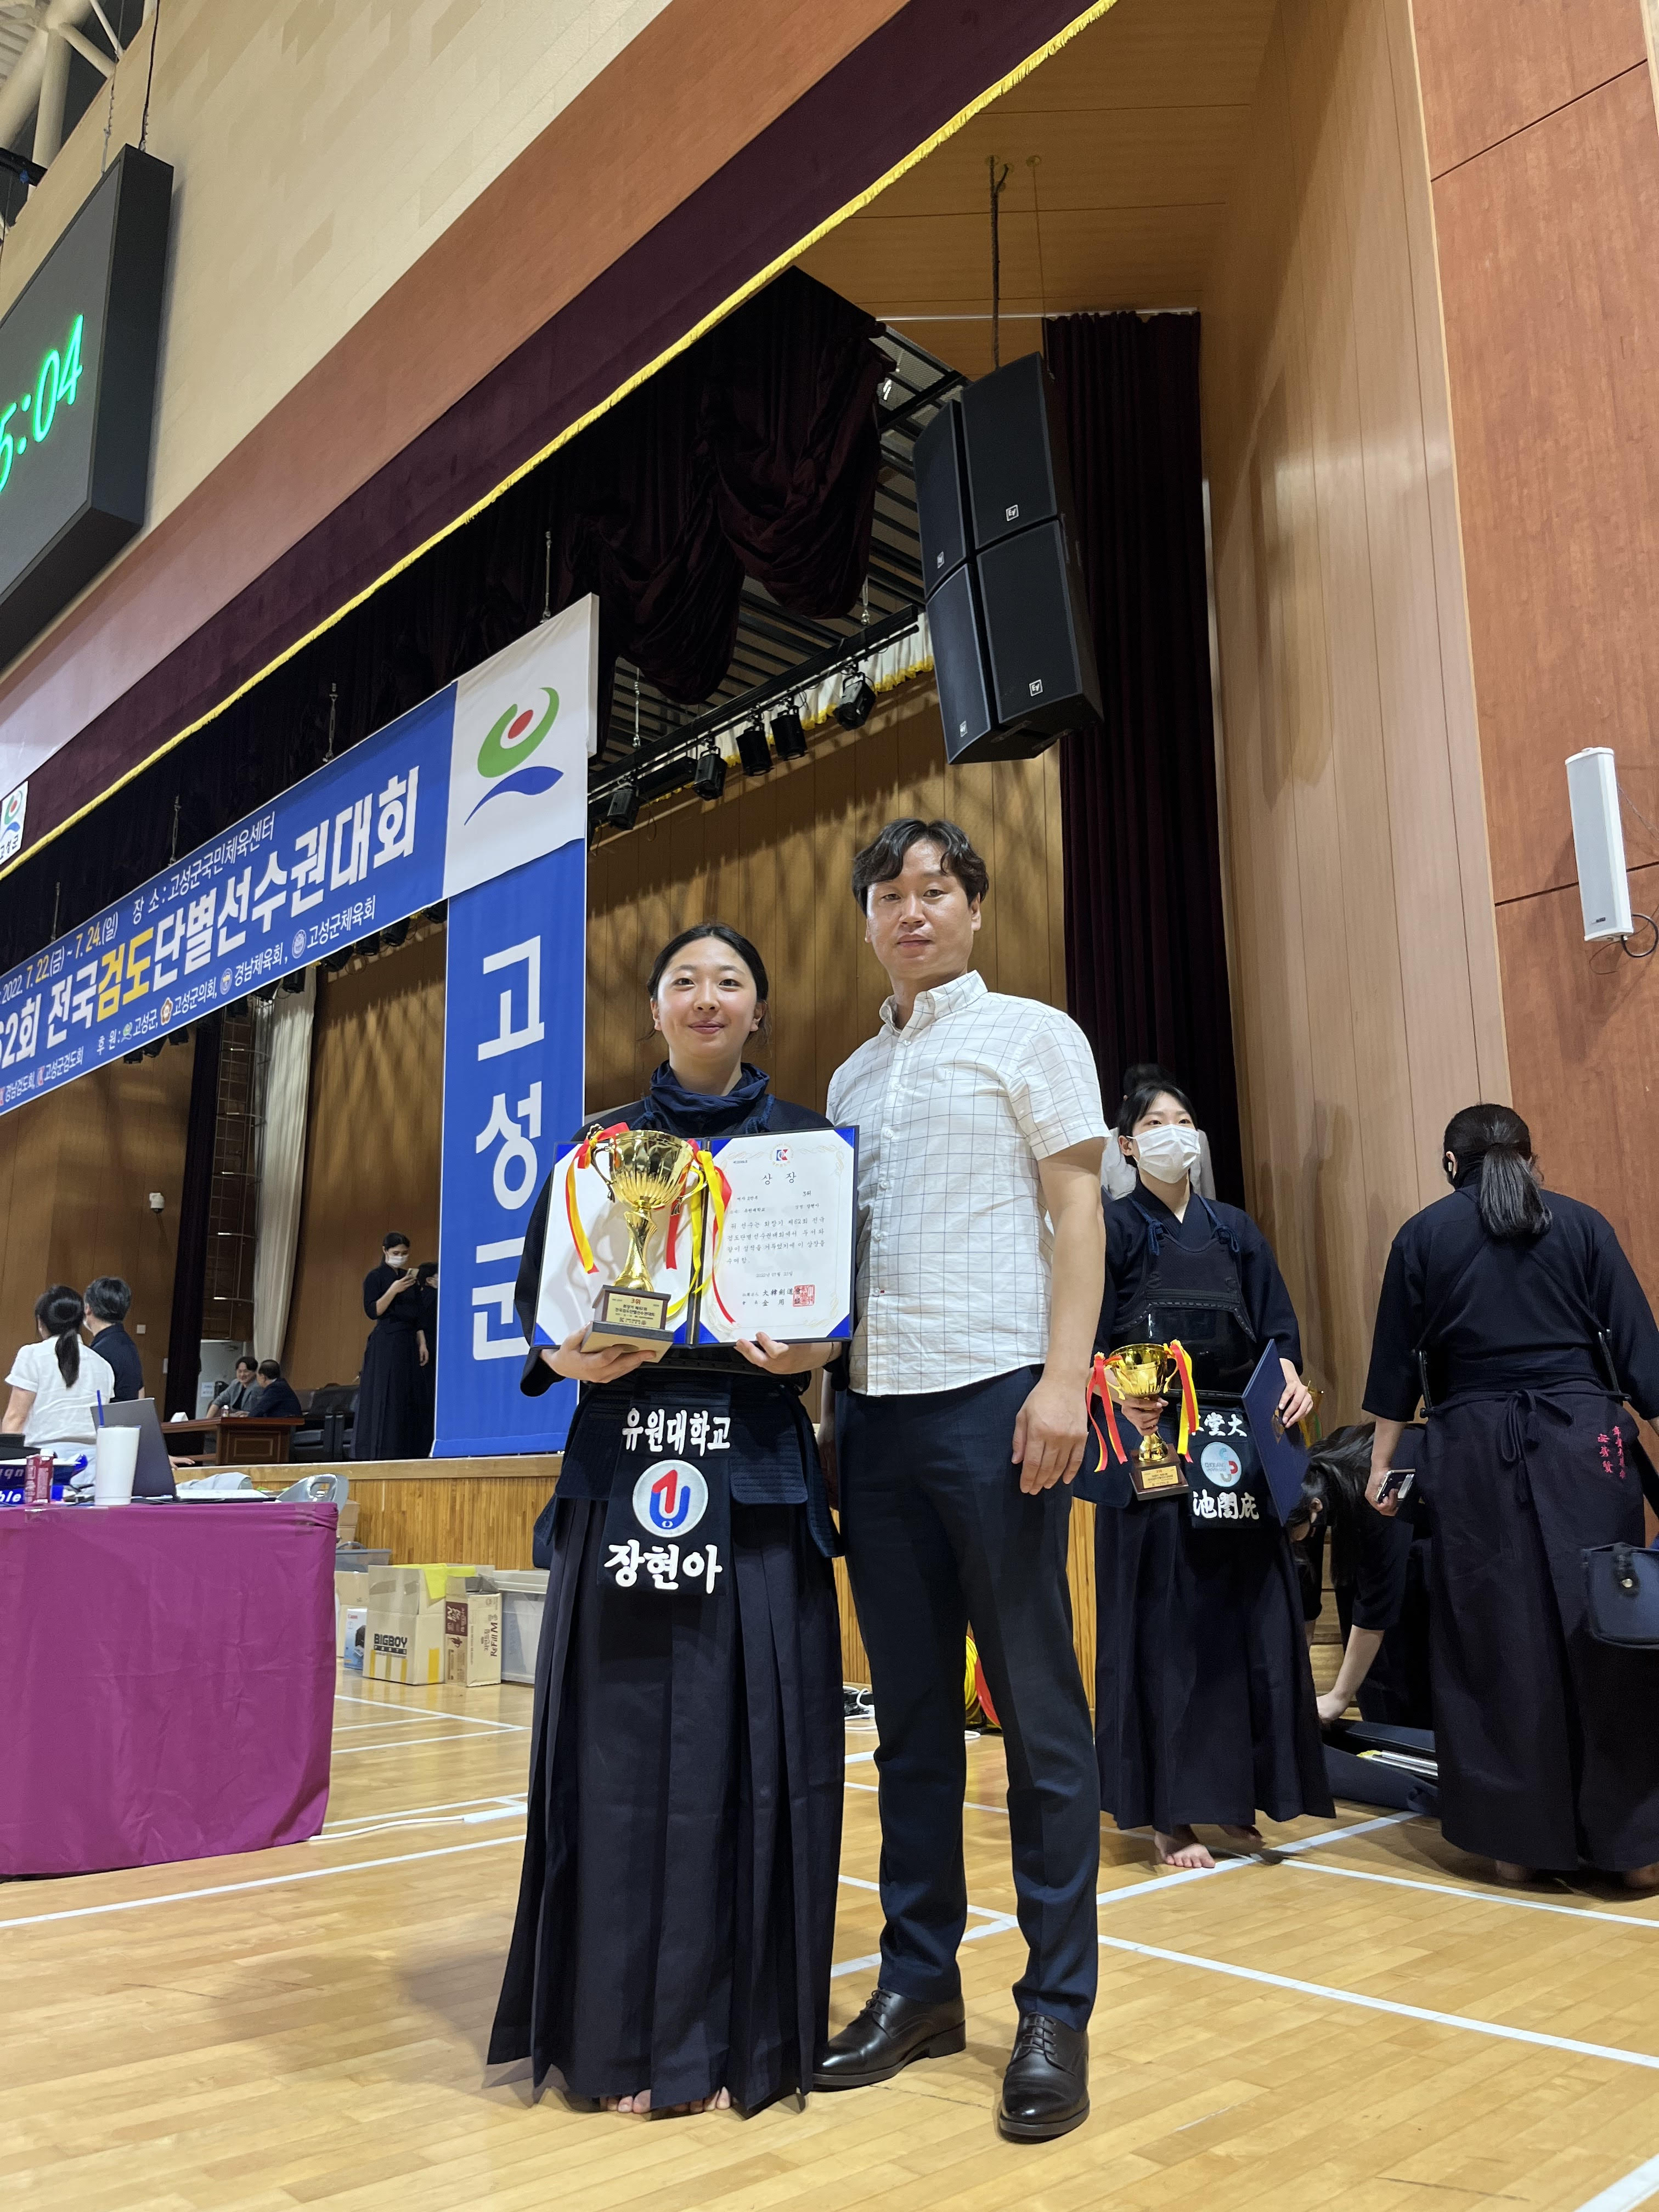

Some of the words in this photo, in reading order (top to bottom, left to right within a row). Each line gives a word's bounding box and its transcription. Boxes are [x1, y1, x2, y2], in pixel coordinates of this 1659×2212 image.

[168, 811, 275, 901] 고성군국민체육센터
[307, 895, 376, 949] 고성군체육회
[0, 993, 42, 1069] 2회
[622, 1408, 731, 1457] 유원대학교
[604, 1539, 723, 1594] 장현아
[374, 1633, 408, 1648] BIGBOY
